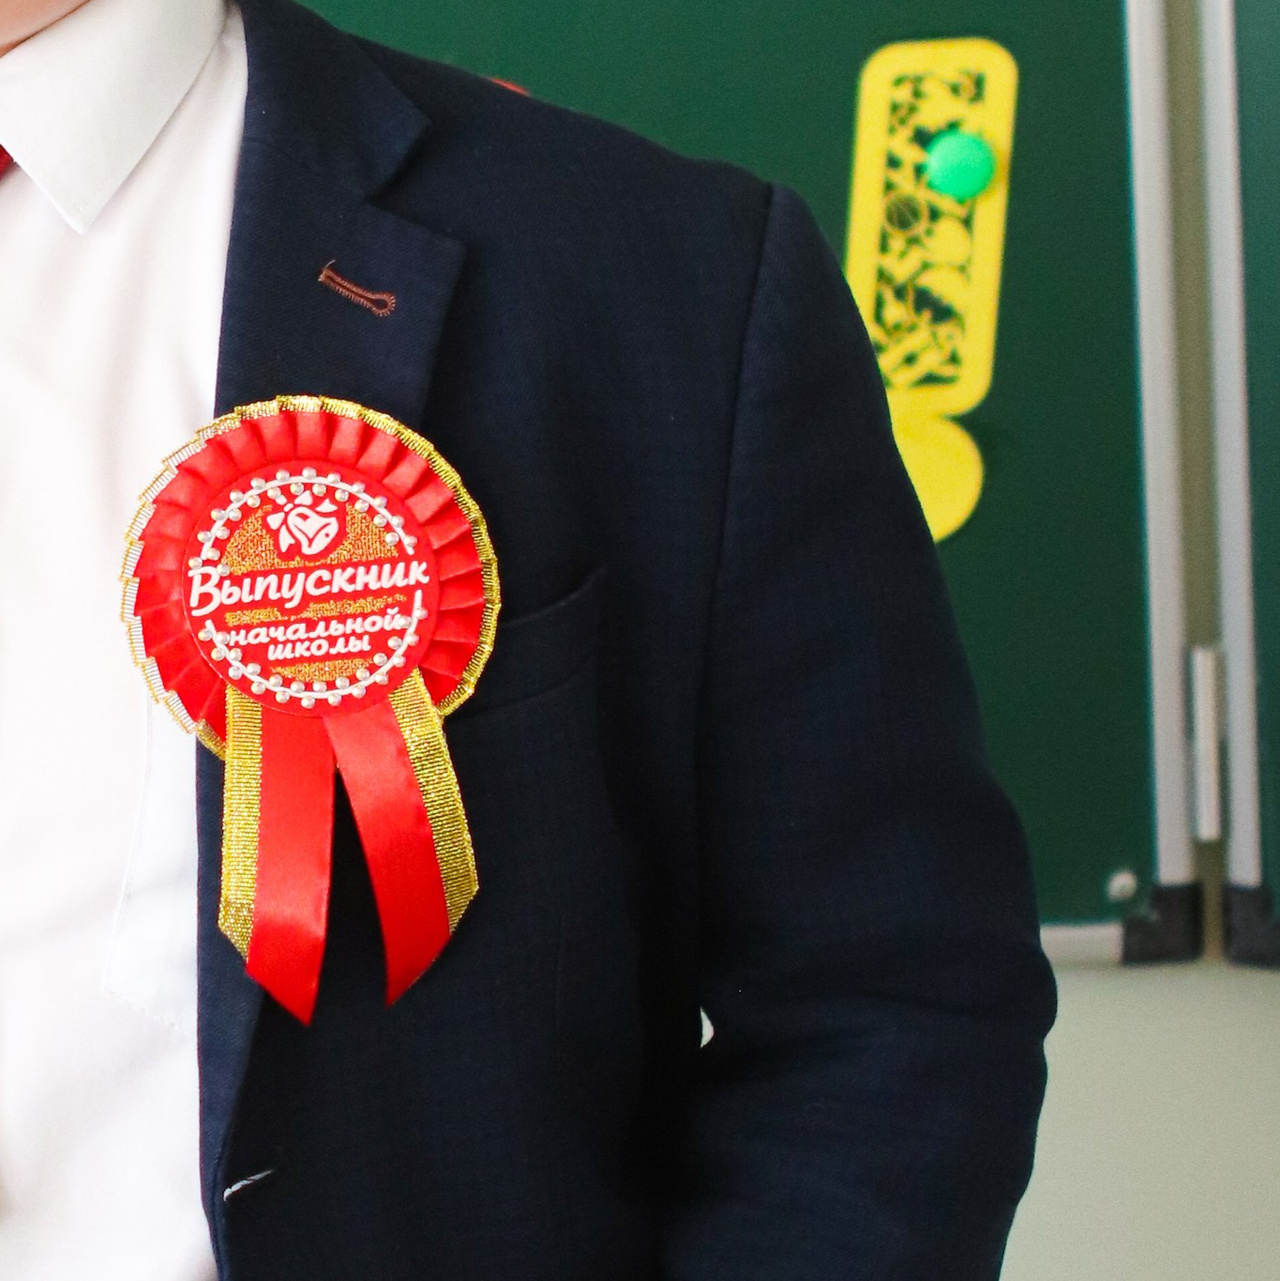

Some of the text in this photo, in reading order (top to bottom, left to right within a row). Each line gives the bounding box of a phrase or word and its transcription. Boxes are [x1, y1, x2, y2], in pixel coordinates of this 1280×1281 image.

[187, 560, 430, 617] Выпускник
[227, 607, 404, 647] начальной
[267, 634, 372, 660] школы
